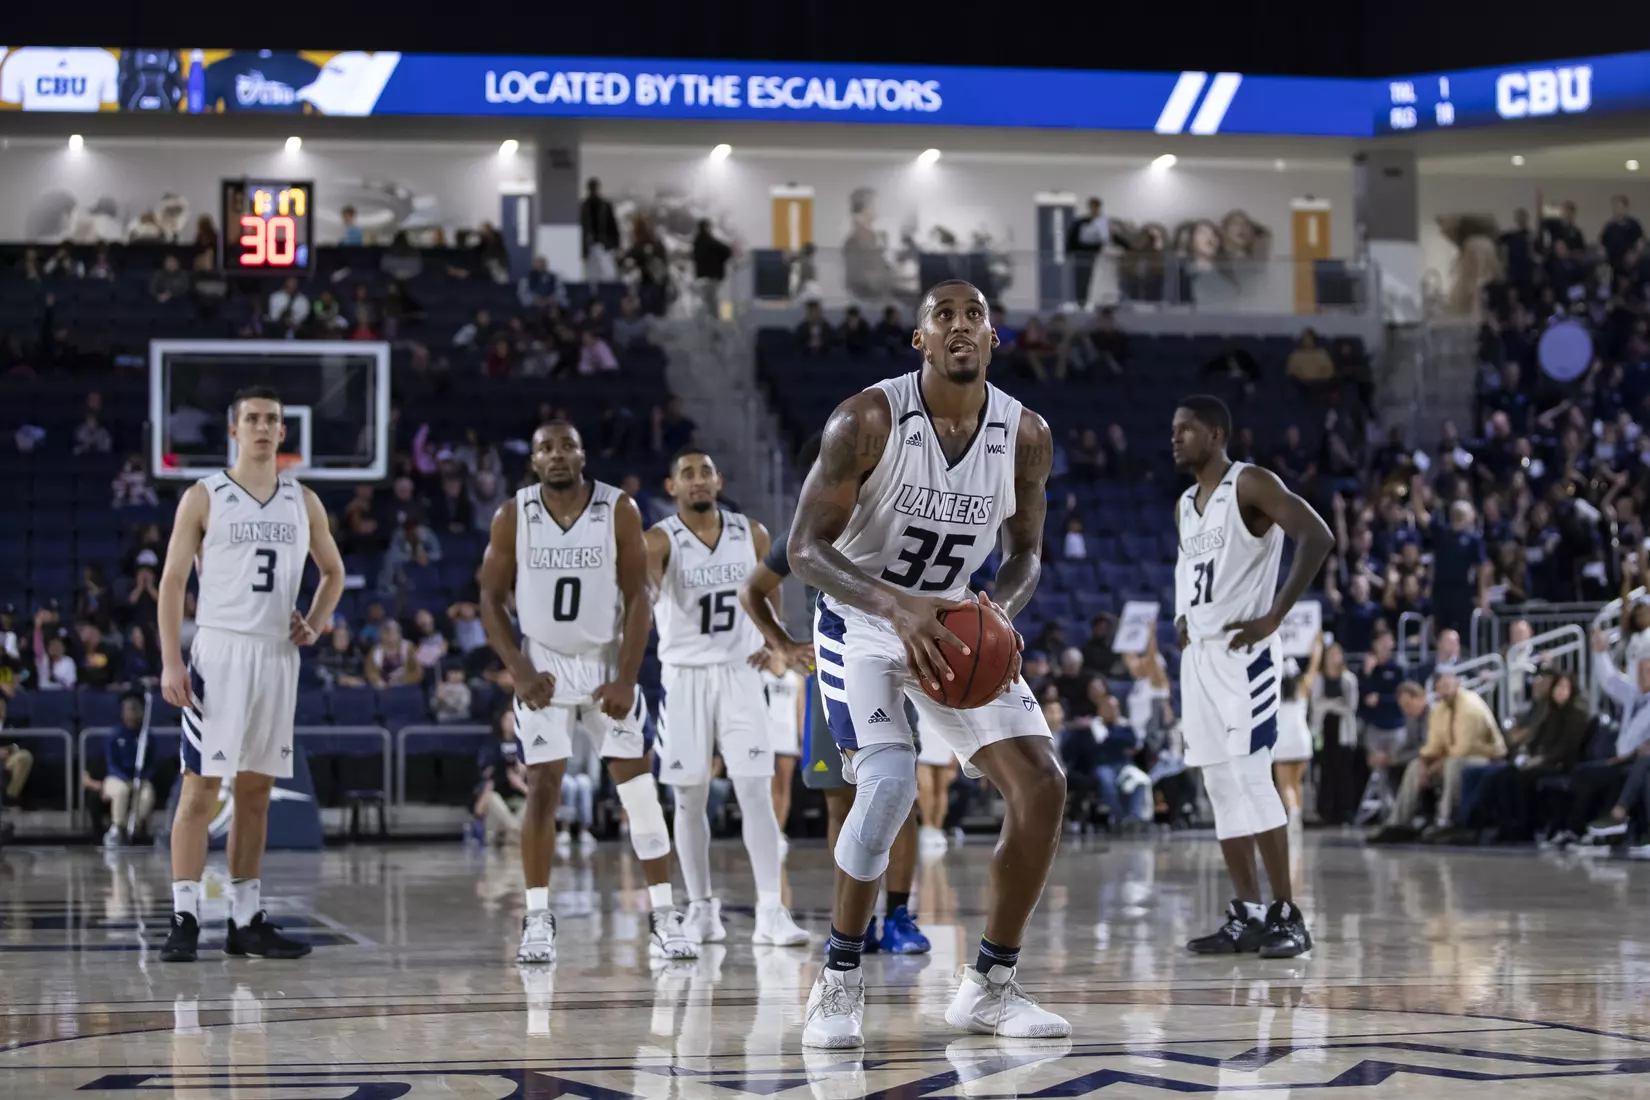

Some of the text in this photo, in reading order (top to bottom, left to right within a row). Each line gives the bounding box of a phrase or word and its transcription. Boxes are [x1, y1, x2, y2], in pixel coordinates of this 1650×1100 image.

[36, 76, 87, 96] CBU
[485, 69, 942, 112] LOCATED BY THE ESCALATORS
[1496, 64, 1593, 119] CBU
[240, 215, 297, 266] 30
[894, 484, 994, 525] LANCERS
[230, 521, 297, 544] LANCERS
[252, 548, 277, 592] 3
[528, 546, 602, 569] LANCERS
[682, 562, 747, 588] LANCERS
[881, 525, 977, 591] 35
[553, 577, 581, 622] 0
[1191, 557, 1214, 607] 31
[699, 590, 737, 635] 15
